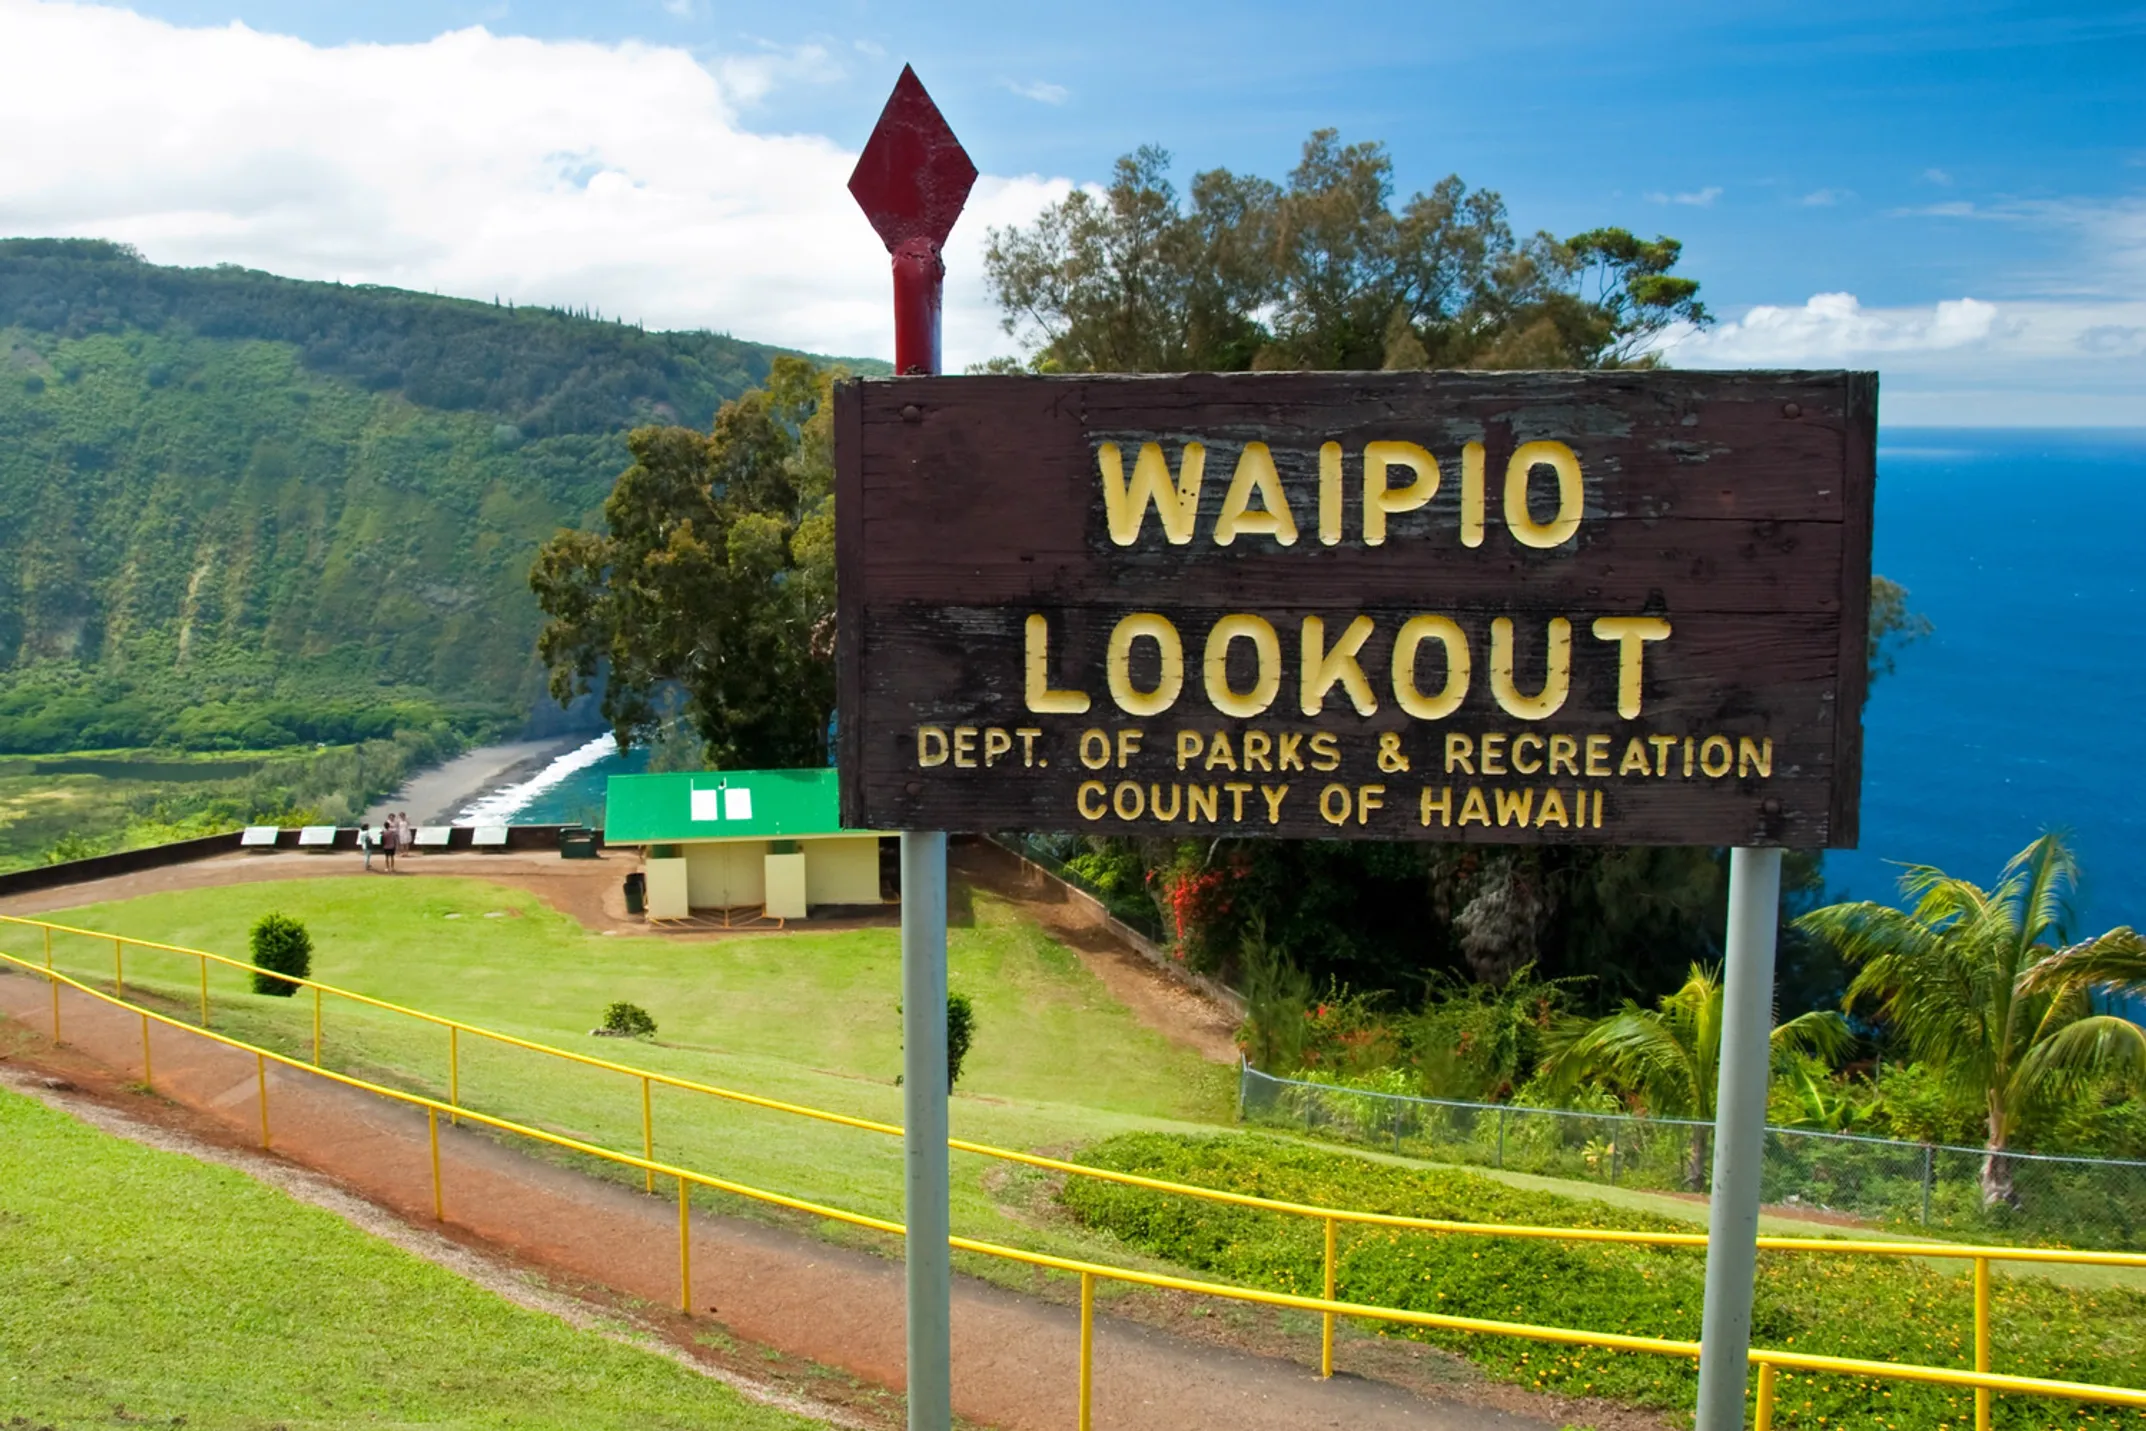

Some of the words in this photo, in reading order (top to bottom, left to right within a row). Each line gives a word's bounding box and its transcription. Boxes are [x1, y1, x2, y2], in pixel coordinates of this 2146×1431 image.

[1099, 441, 1585, 548] WAIPIO
[1025, 613, 1672, 720] LOOKOUT
[918, 727, 1048, 767] DEPT.
[1080, 729, 1144, 770] OF
[1176, 731, 1341, 772] PARKS
[1378, 732, 1410, 773] &
[1446, 733, 1772, 778] RECREATION
[1077, 780, 1289, 825] COUNTY
[1319, 783, 1386, 826] OF
[1421, 787, 1603, 829] HAWAII
